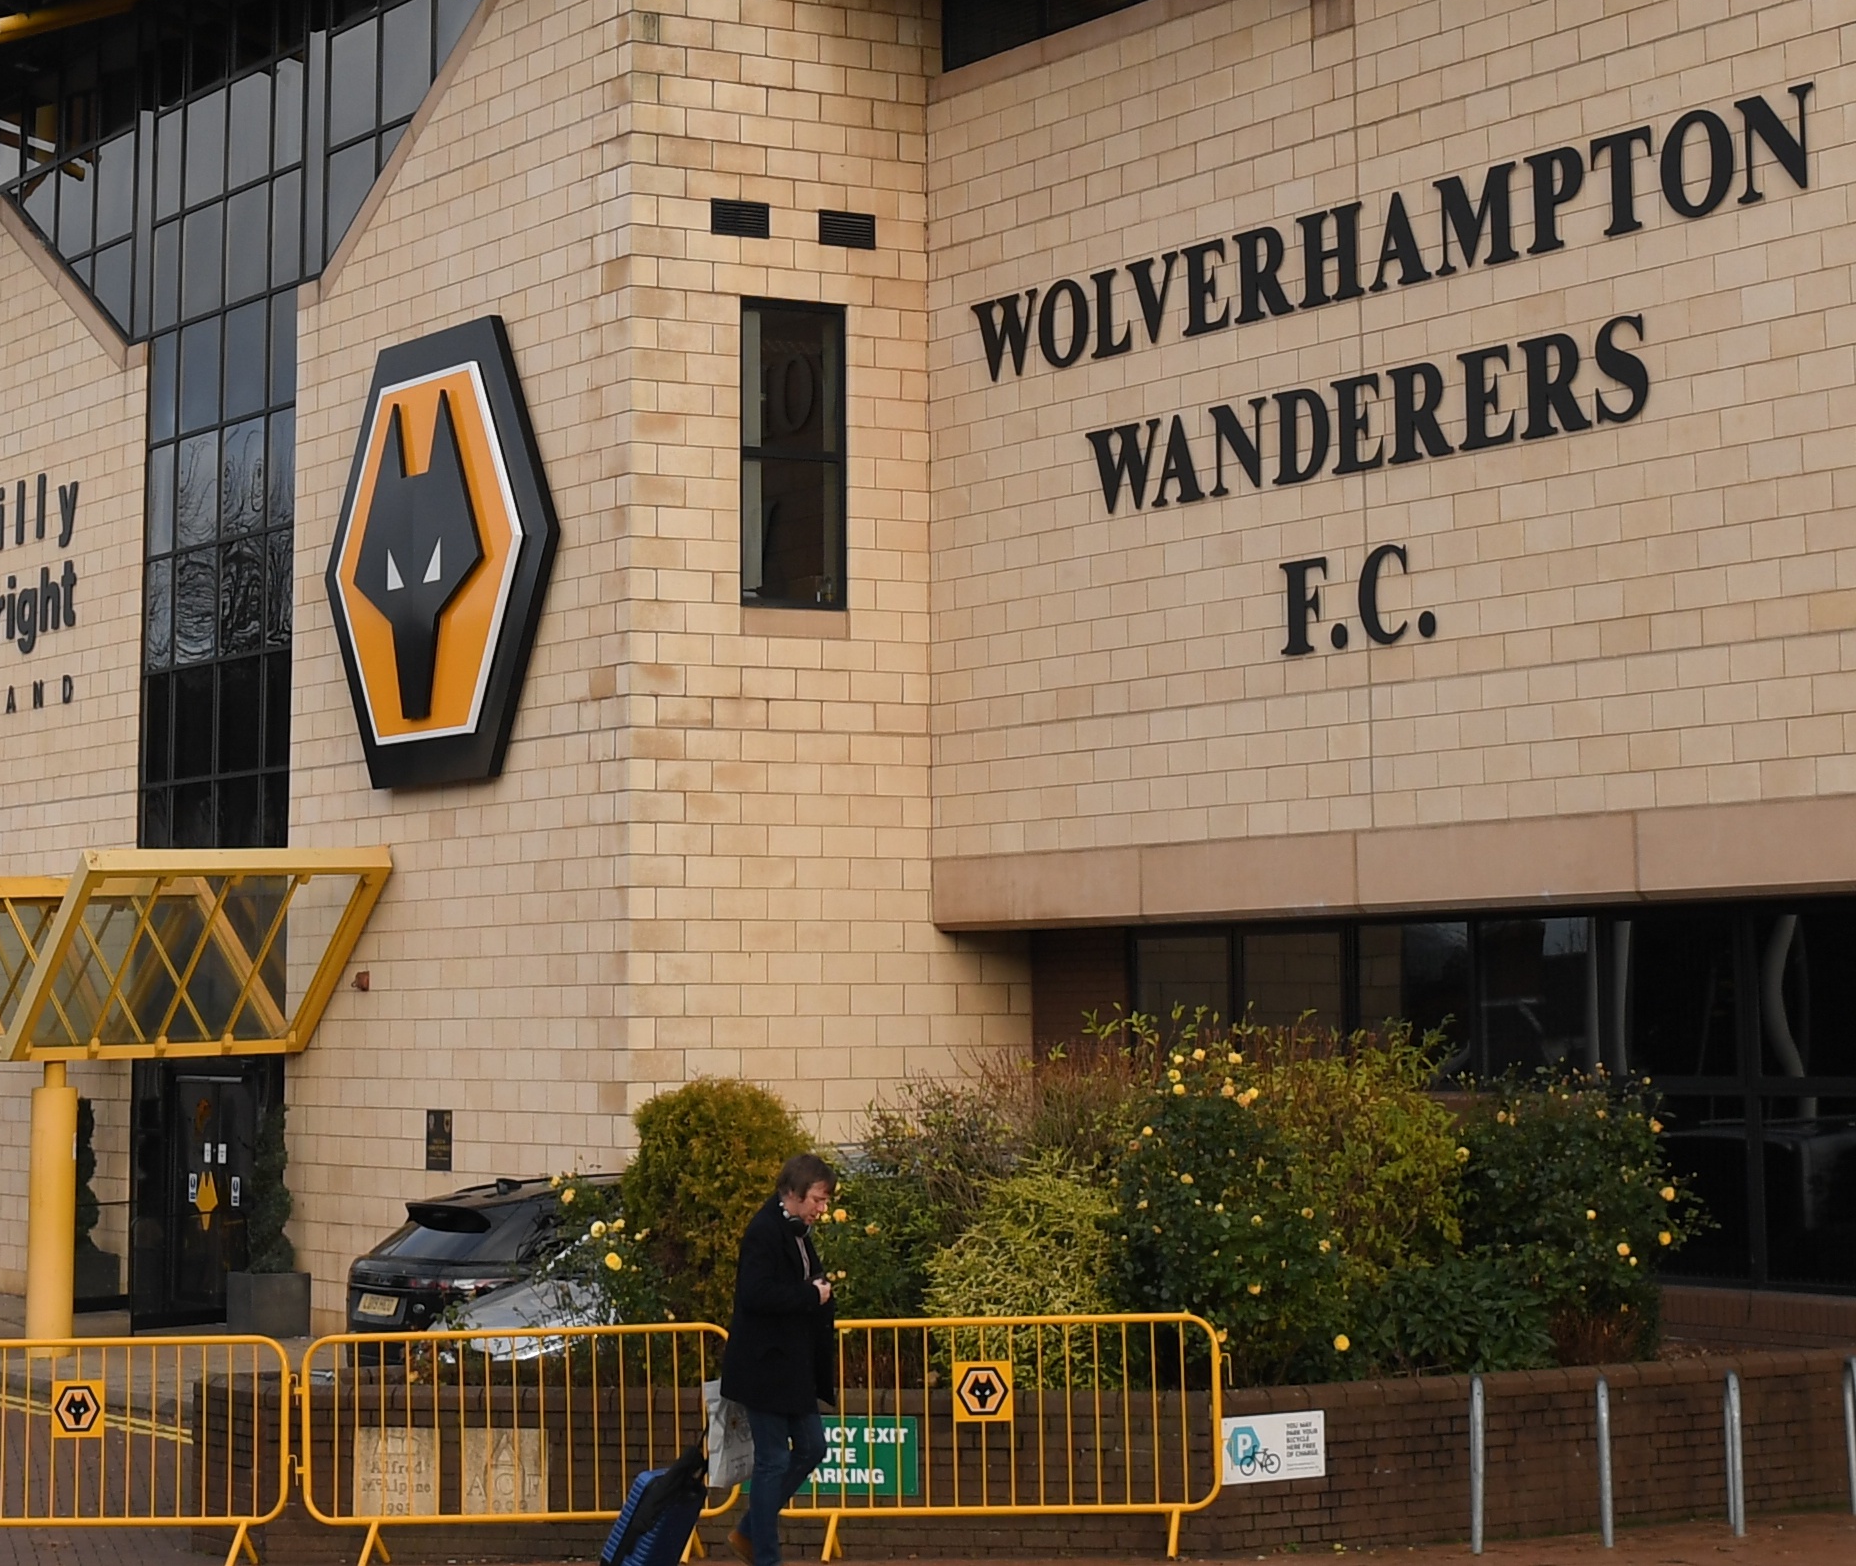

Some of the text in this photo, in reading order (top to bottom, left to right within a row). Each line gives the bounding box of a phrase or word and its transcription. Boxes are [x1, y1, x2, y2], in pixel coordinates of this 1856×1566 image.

[971, 82, 1815, 383] WOLVERHAMPTON
[1086, 313, 1650, 515] WANDERERS
[1280, 544, 1437, 656] F.C.
[864, 1427, 908, 1443] EXIT
[1286, 1435, 1310, 1444] BICYCLE
[1237, 1433, 1253, 1459] P
[822, 1448, 856, 1463] UTE
[807, 1468, 885, 1484] ARKING
[361, 1478, 431, 1495] McAlpne
